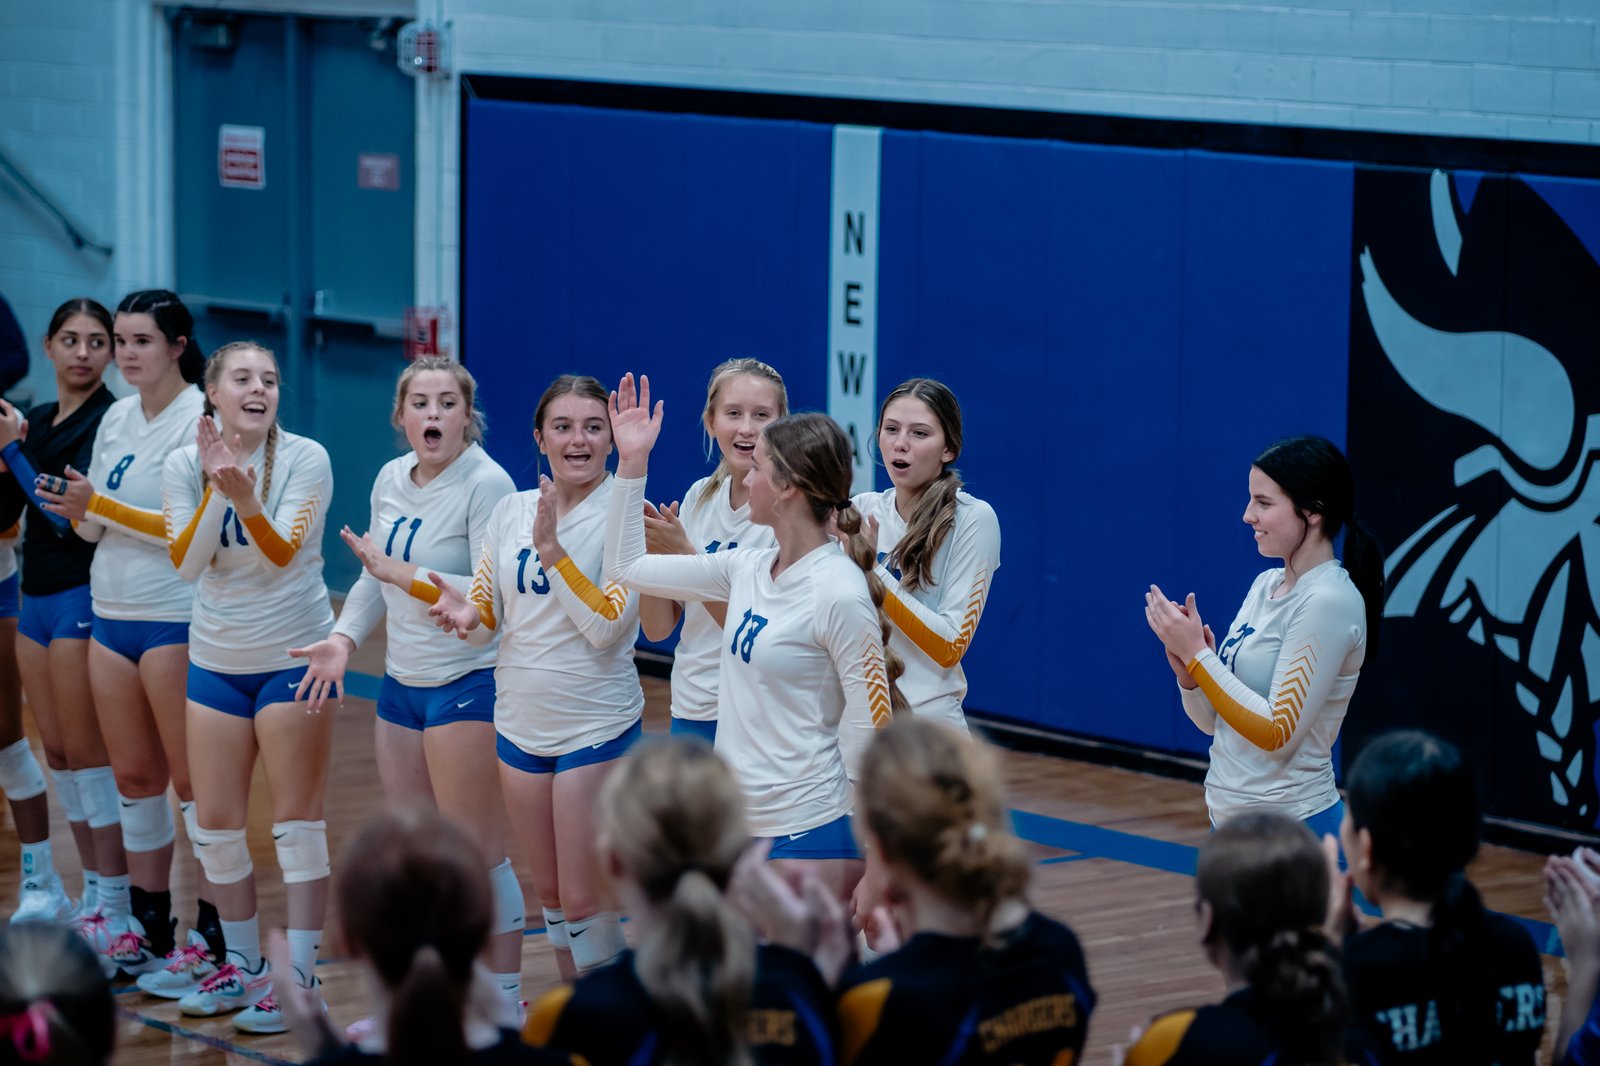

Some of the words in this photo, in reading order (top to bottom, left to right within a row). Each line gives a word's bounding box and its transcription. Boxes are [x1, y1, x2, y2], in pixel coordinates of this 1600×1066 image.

[106, 453, 136, 491] 8
[385, 516, 423, 562] 11
[517, 548, 551, 595] 13
[731, 607, 768, 664] 18
